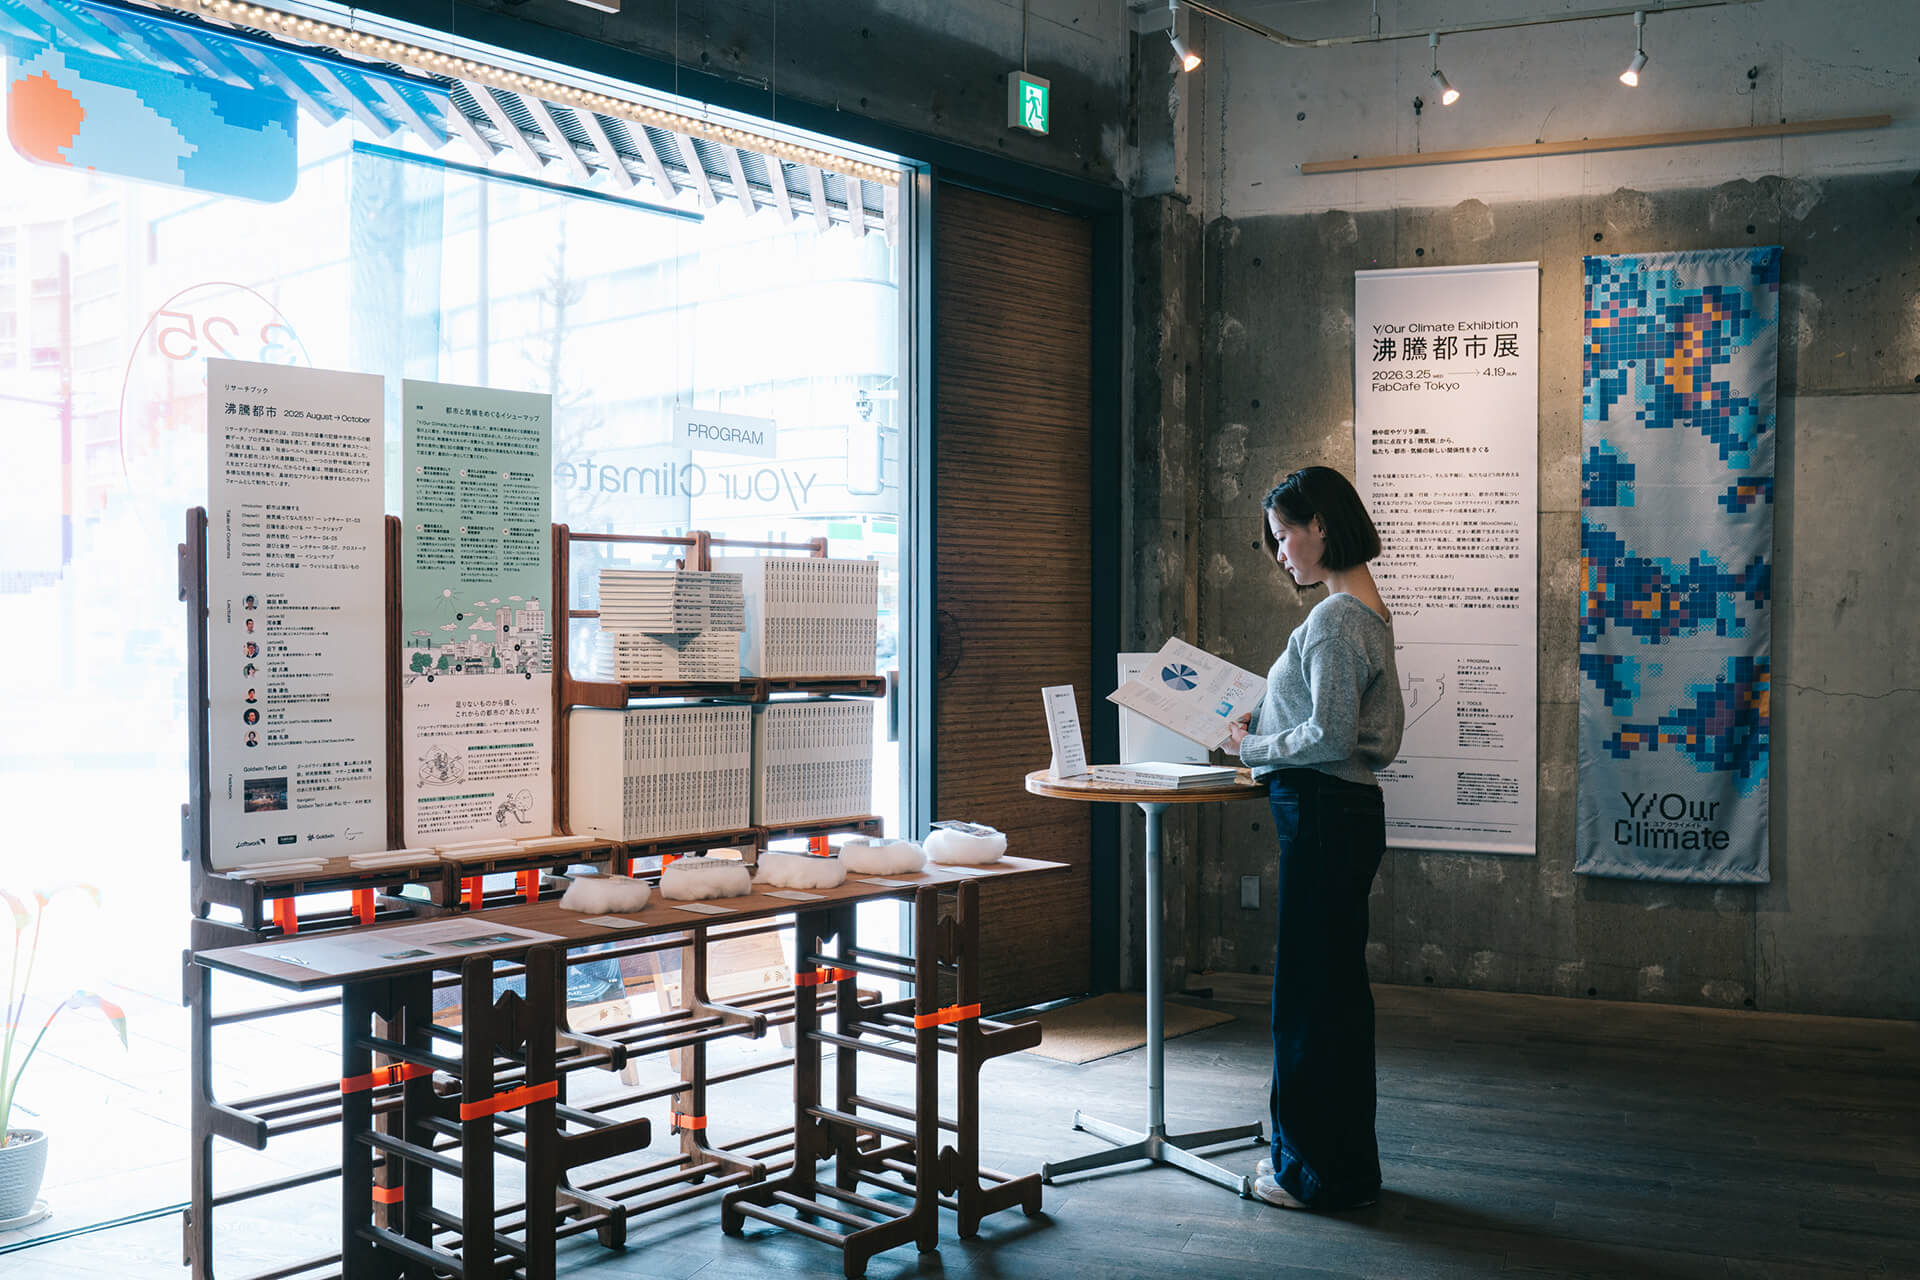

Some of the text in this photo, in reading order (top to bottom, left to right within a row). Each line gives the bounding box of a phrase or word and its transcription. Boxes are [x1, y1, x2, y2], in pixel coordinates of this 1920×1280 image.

[1373, 320, 1518, 334] Y/Our Climate Exhibition
[1372, 334, 1519, 362] 沸騰都市展
[1372, 370, 1431, 380] 2026.3.25
[1483, 367, 1506, 376] 4.19
[224, 383, 269, 394] リサーチブック
[1372, 381, 1460, 392] FabCafe Tokyo
[224, 402, 371, 424] 沸騰都市 2025 August October
[446, 406, 540, 422] 都市と気候をめぐるイシューマップ
[687, 422, 764, 446] PROGRAM
[1621, 792, 1720, 822] Y/Our
[1614, 820, 1730, 850] Climate
